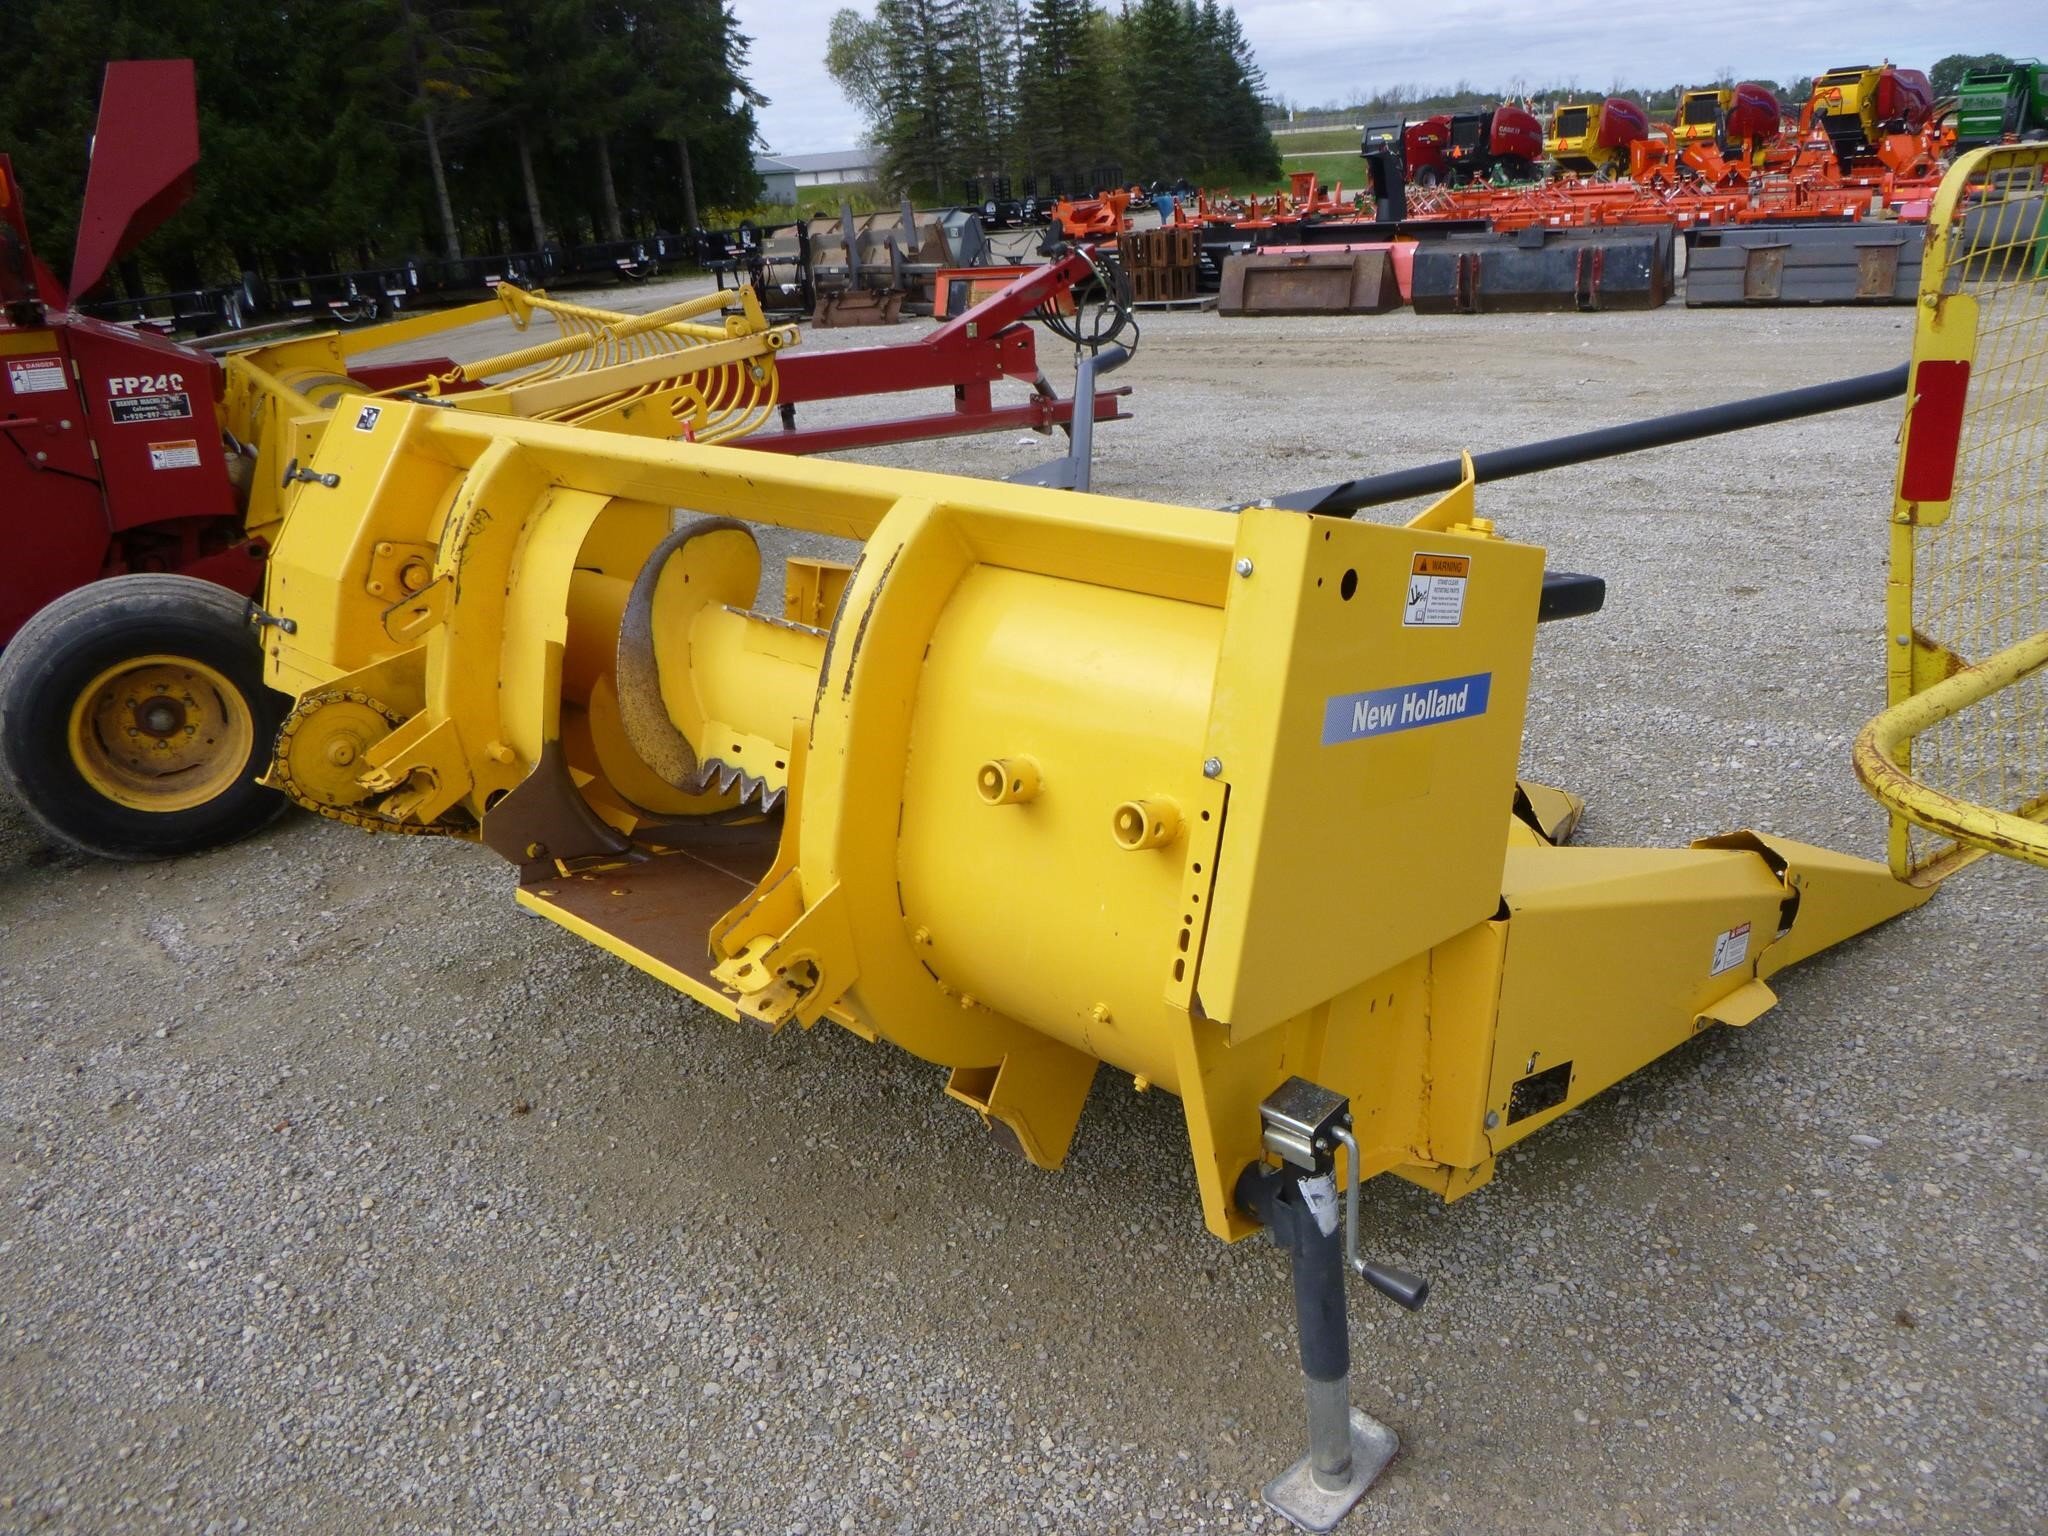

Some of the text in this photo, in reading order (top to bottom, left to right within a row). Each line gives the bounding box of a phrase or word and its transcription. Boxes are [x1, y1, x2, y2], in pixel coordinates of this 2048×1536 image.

[25, 361, 54, 369] DANGER
[1432, 559, 1462, 573] WARNING
[1351, 683, 1469, 733] New Holland
